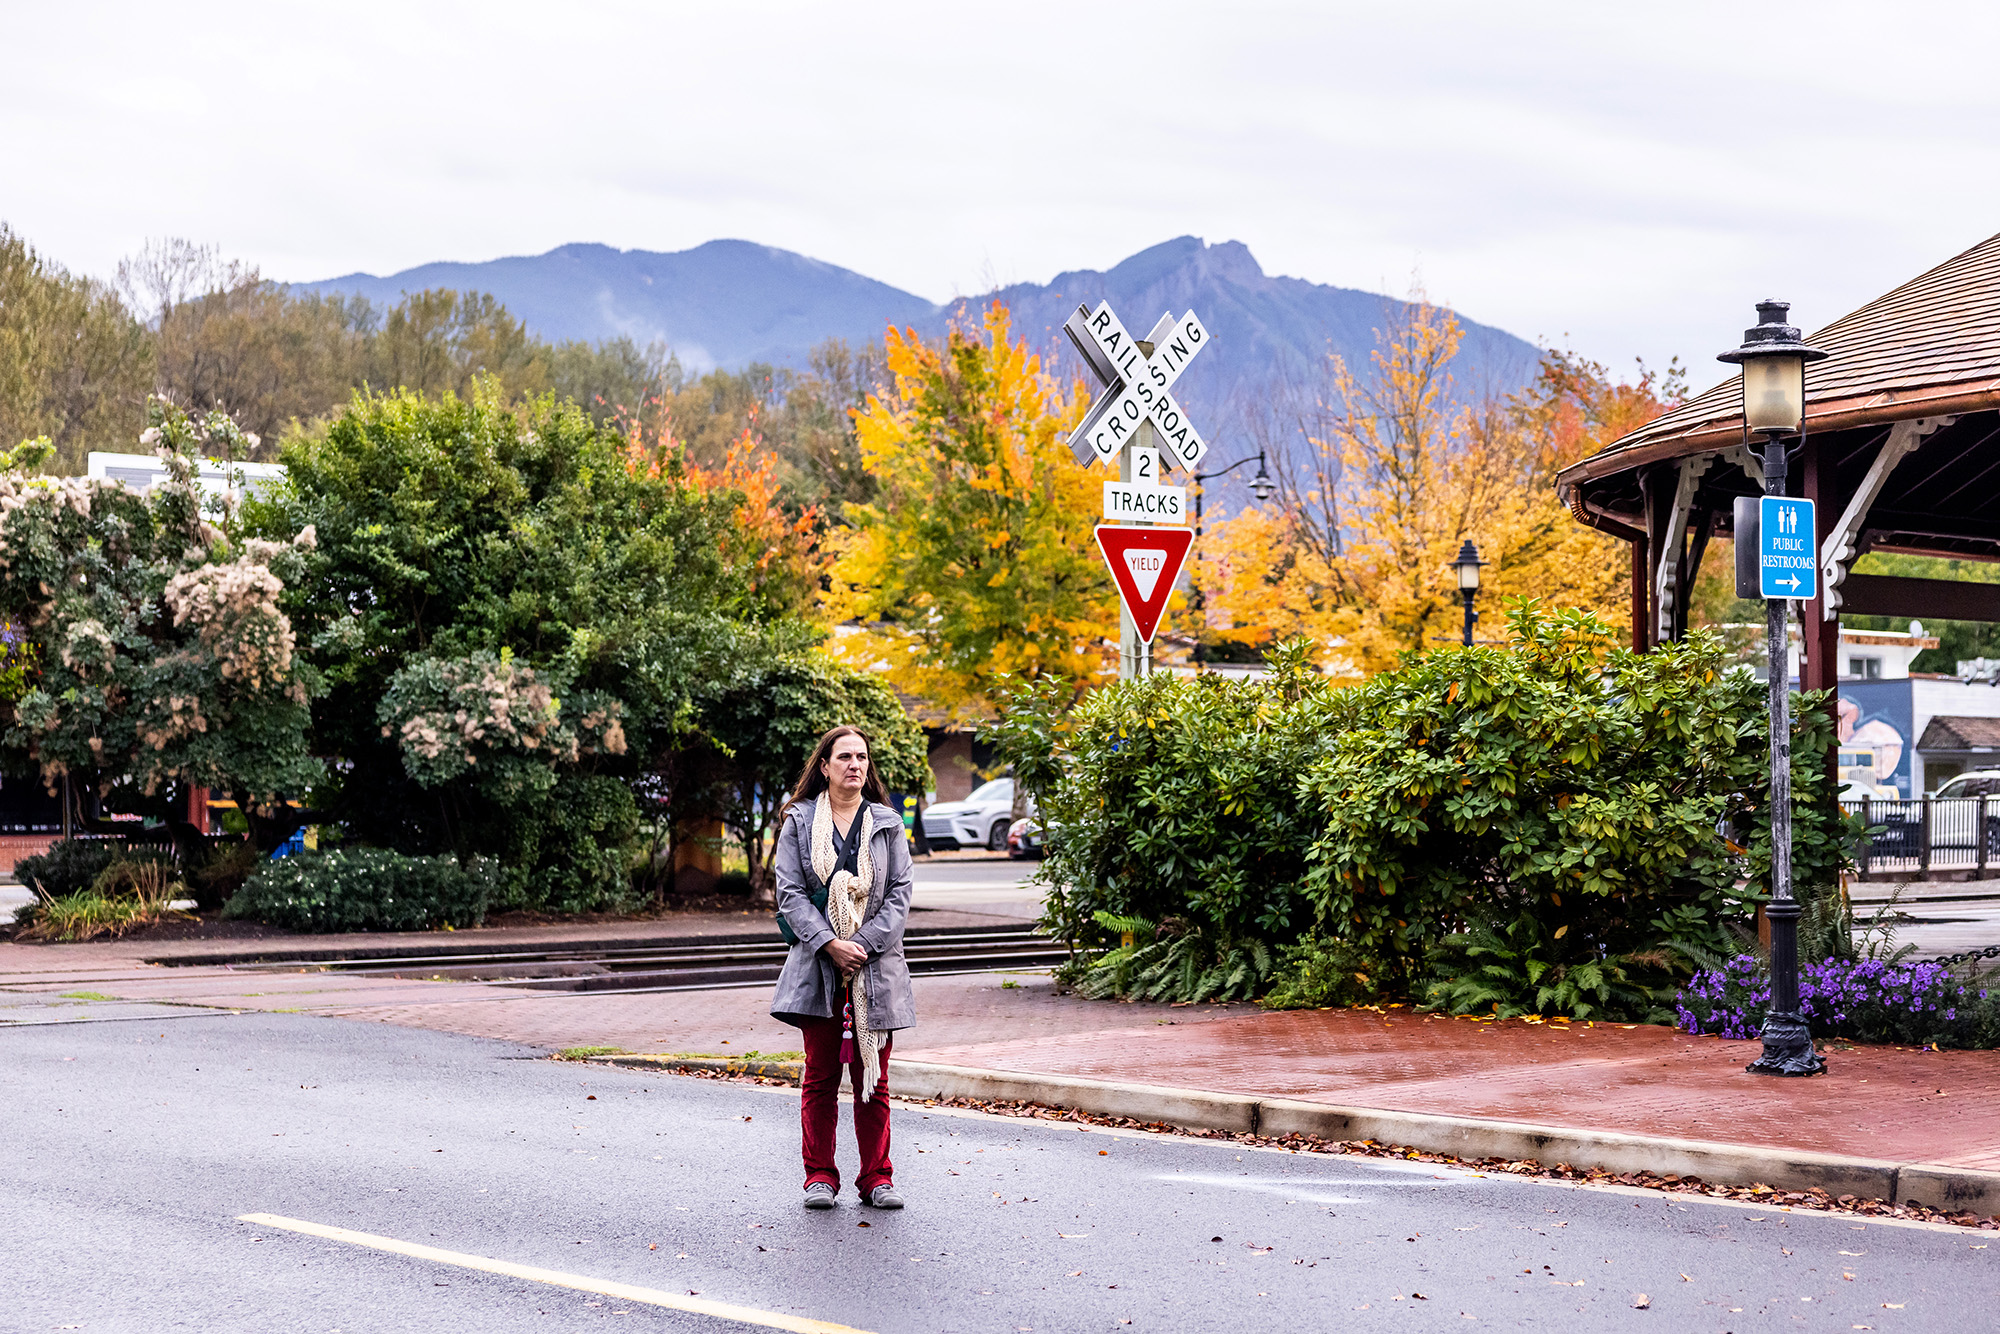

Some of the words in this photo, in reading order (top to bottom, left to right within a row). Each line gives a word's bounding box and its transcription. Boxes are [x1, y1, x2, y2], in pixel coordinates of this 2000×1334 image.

[1092, 310, 1137, 379] RAIL
[1152, 395, 1199, 461] ROAD
[1096, 322, 1201, 454] CROSSING
[1139, 454, 1151, 477] 2
[1111, 491, 1179, 514] TRACKS
[1773, 537, 1804, 551] PUBLIC
[1130, 557, 1160, 571] YIELD
[1762, 555, 1815, 569] RESTROOMS
